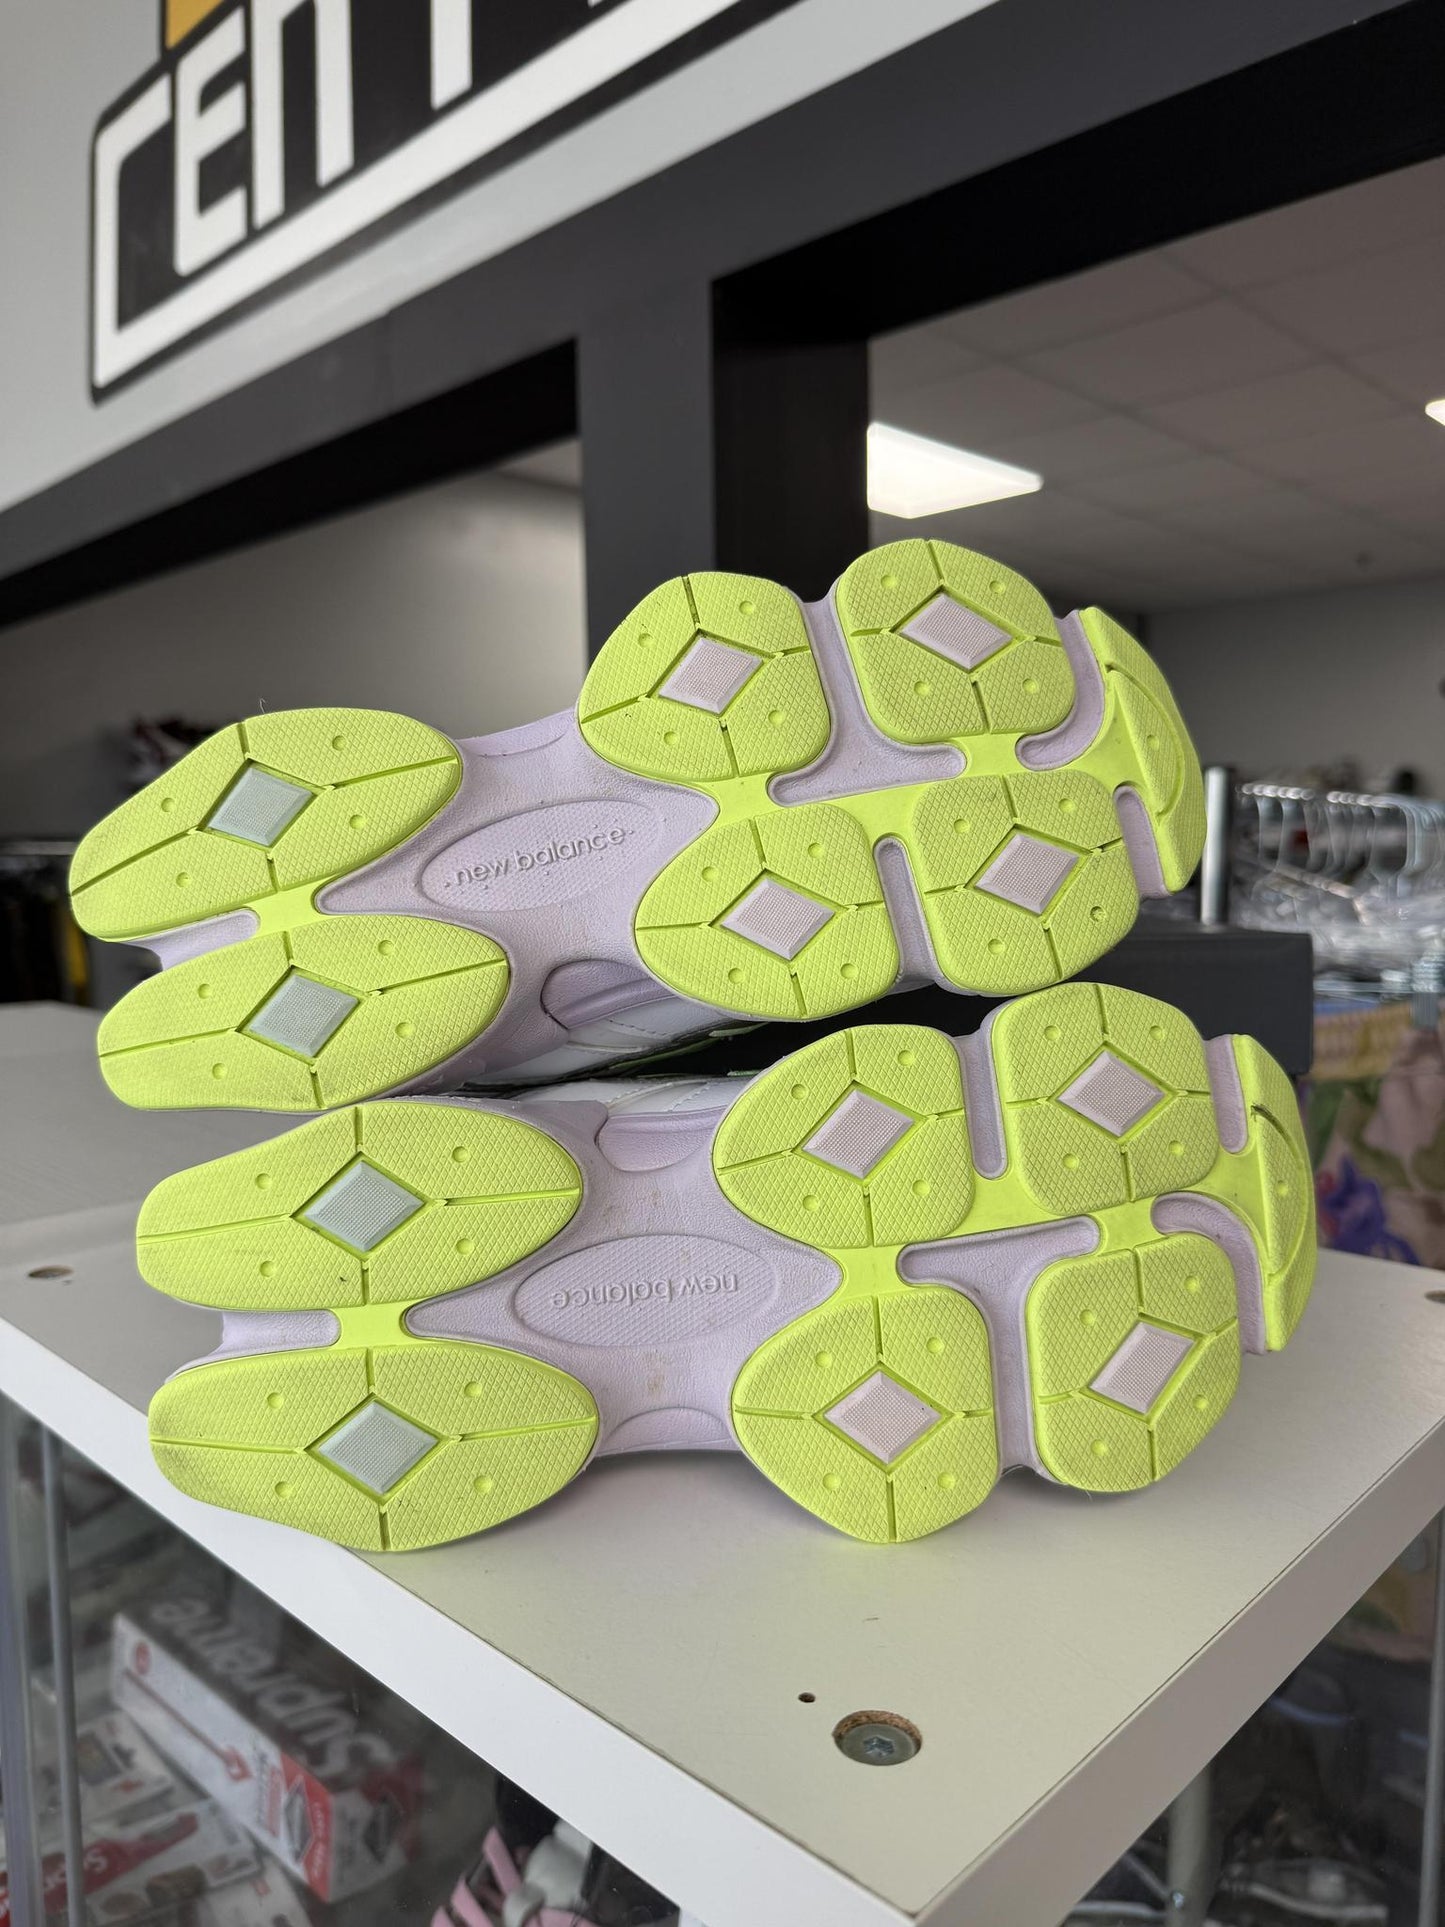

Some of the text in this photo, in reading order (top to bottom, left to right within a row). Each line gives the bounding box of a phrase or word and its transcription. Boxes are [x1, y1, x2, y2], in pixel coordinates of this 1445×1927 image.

[454, 827, 626, 886] new balance
[552, 1272, 738, 1309] new balance
[152, 1601, 396, 1778] Supreme
